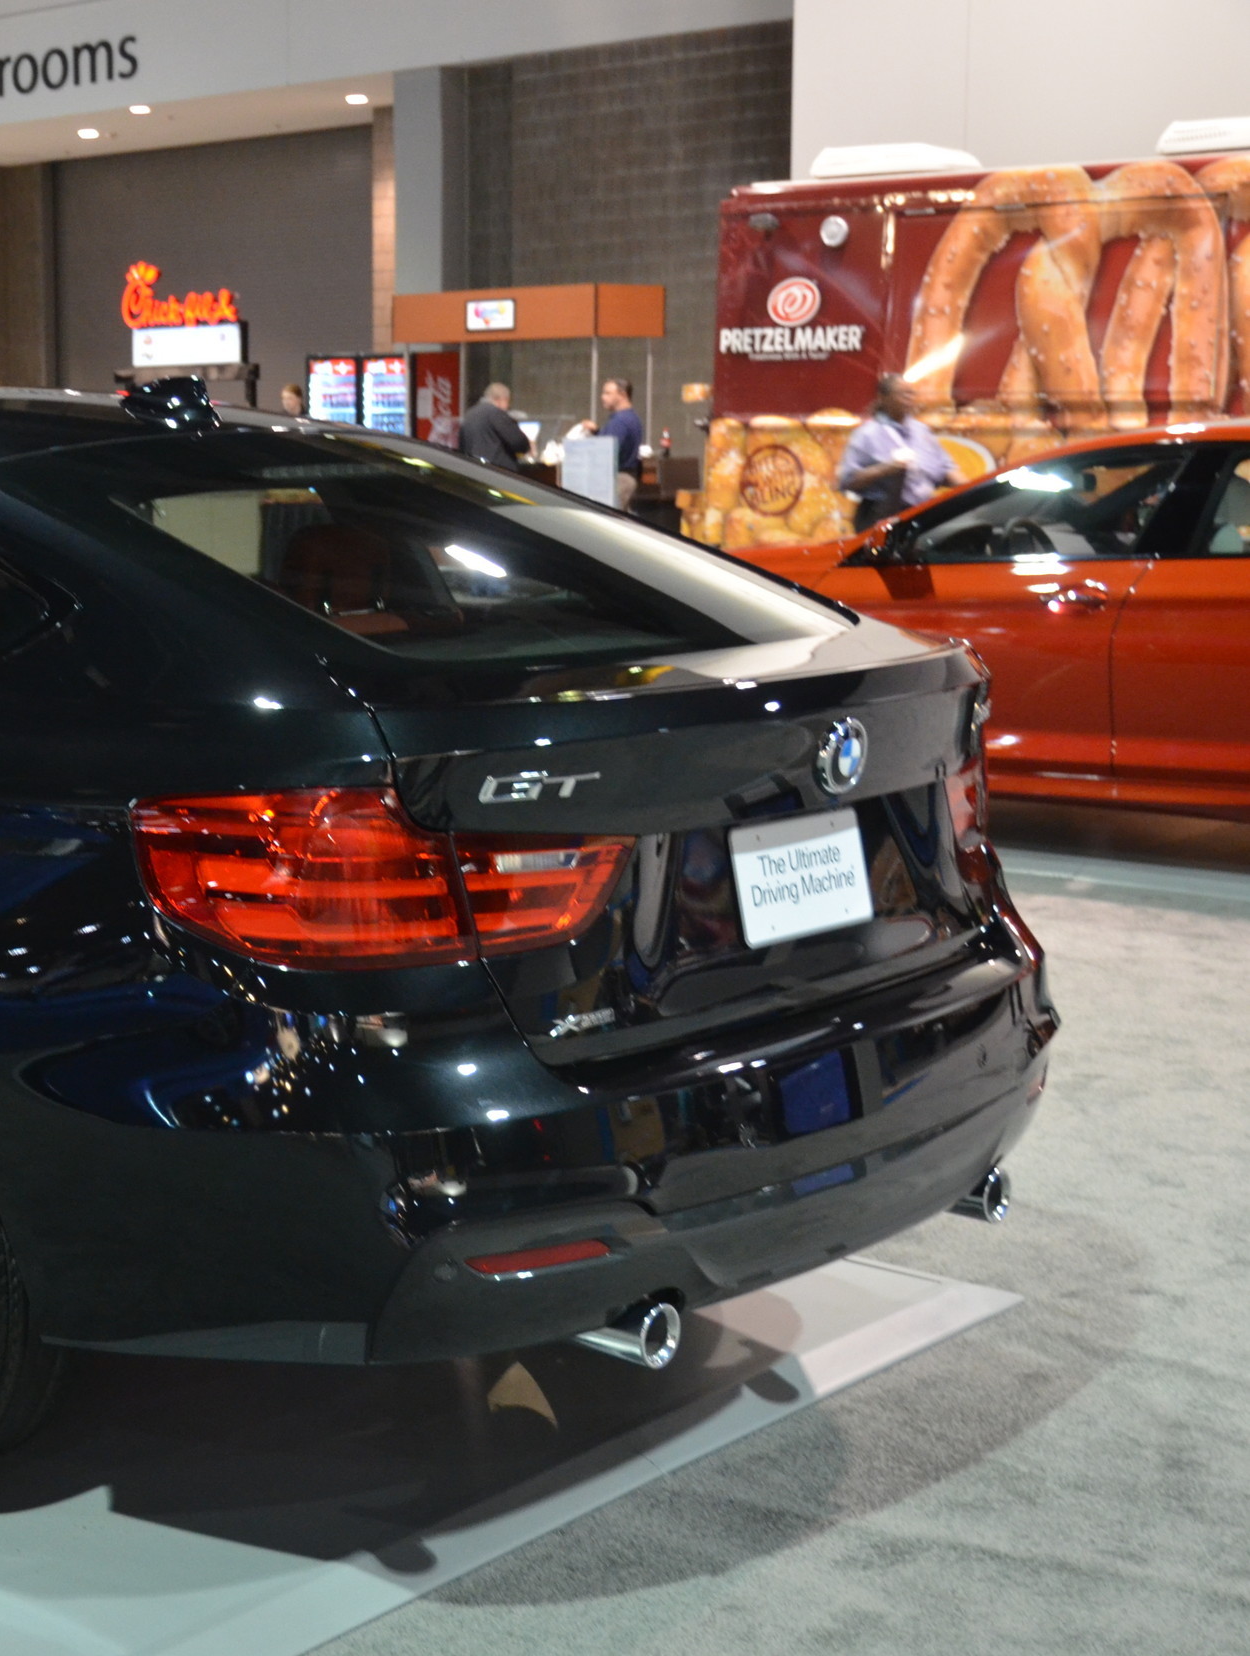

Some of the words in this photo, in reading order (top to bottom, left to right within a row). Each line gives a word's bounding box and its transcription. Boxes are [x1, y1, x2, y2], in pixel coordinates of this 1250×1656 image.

[719, 325, 862, 354] PRETZELMAKER
[478, 769, 601, 804] GT
[757, 854, 786, 877] The
[787, 844, 840, 871] Ultimate
[750, 882, 800, 908] Driving
[800, 869, 855, 896] Machine
